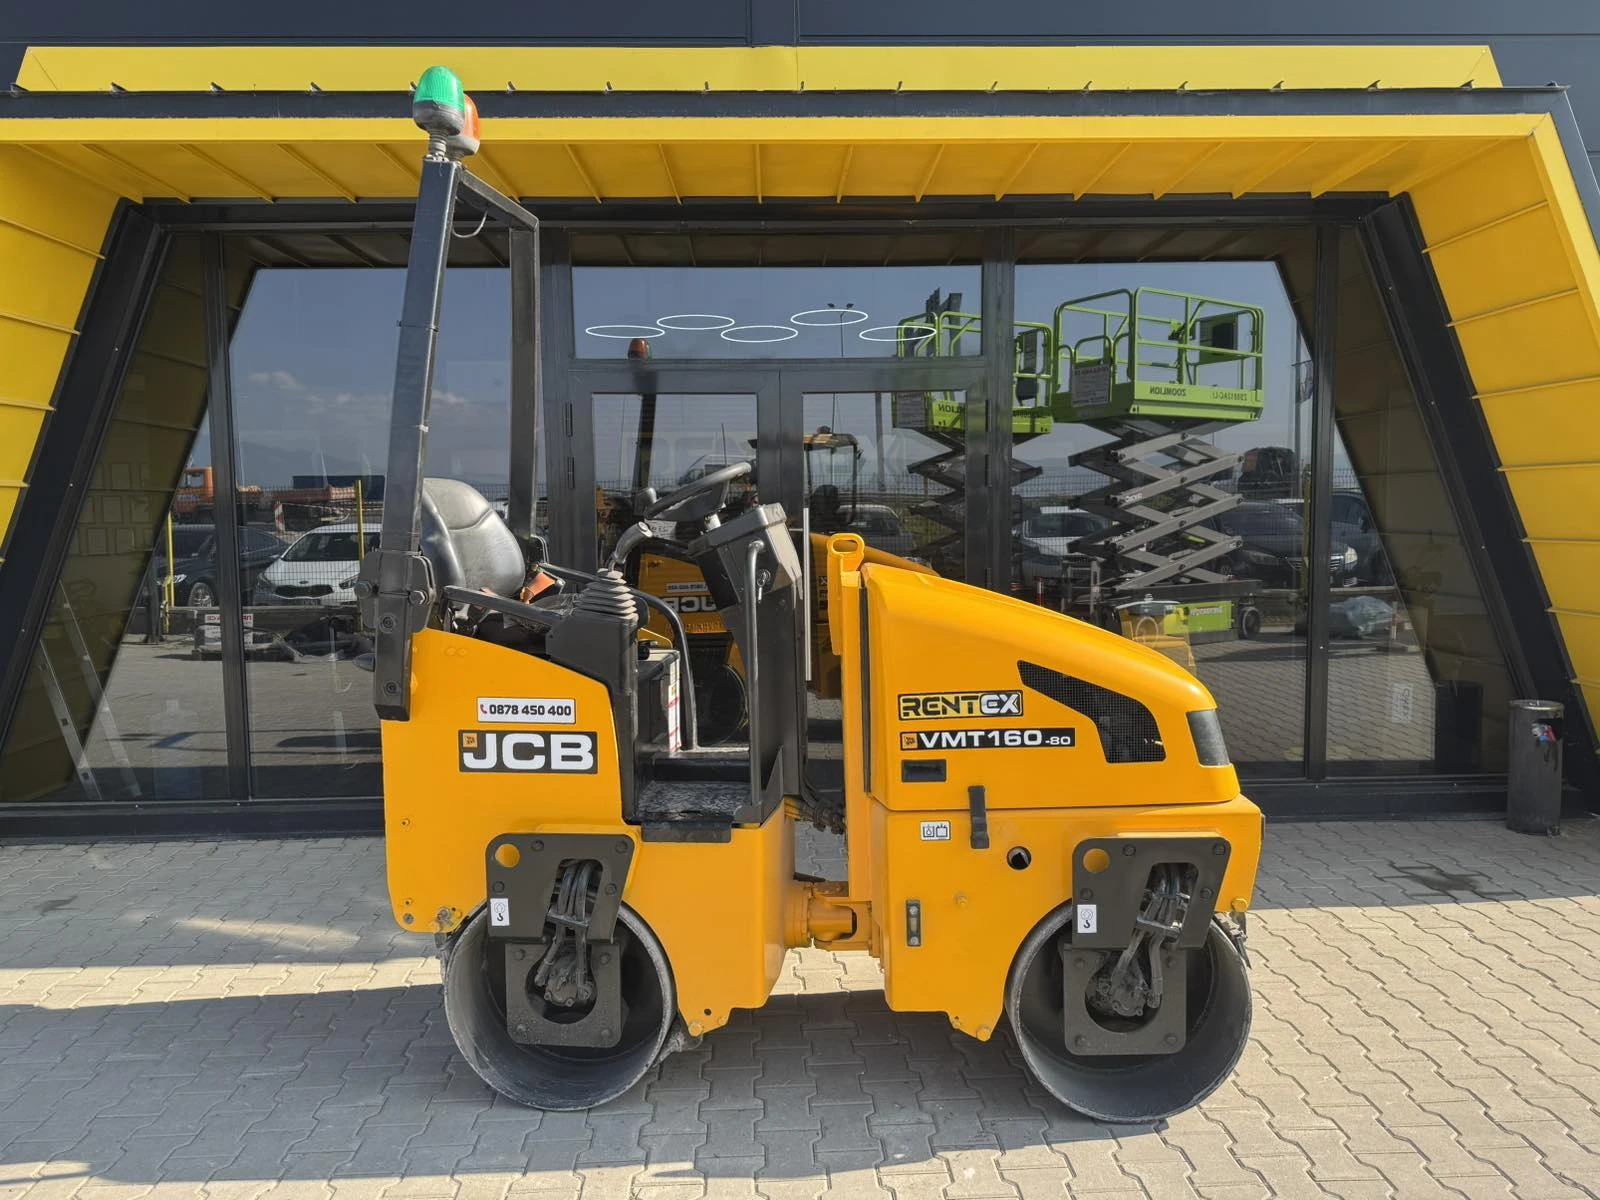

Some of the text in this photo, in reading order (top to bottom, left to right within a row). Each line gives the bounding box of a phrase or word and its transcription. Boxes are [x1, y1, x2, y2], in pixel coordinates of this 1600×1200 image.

[489, 704, 572, 716] 0878 450 400
[902, 693, 1020, 716] RENTEX
[462, 733, 594, 770] JCB
